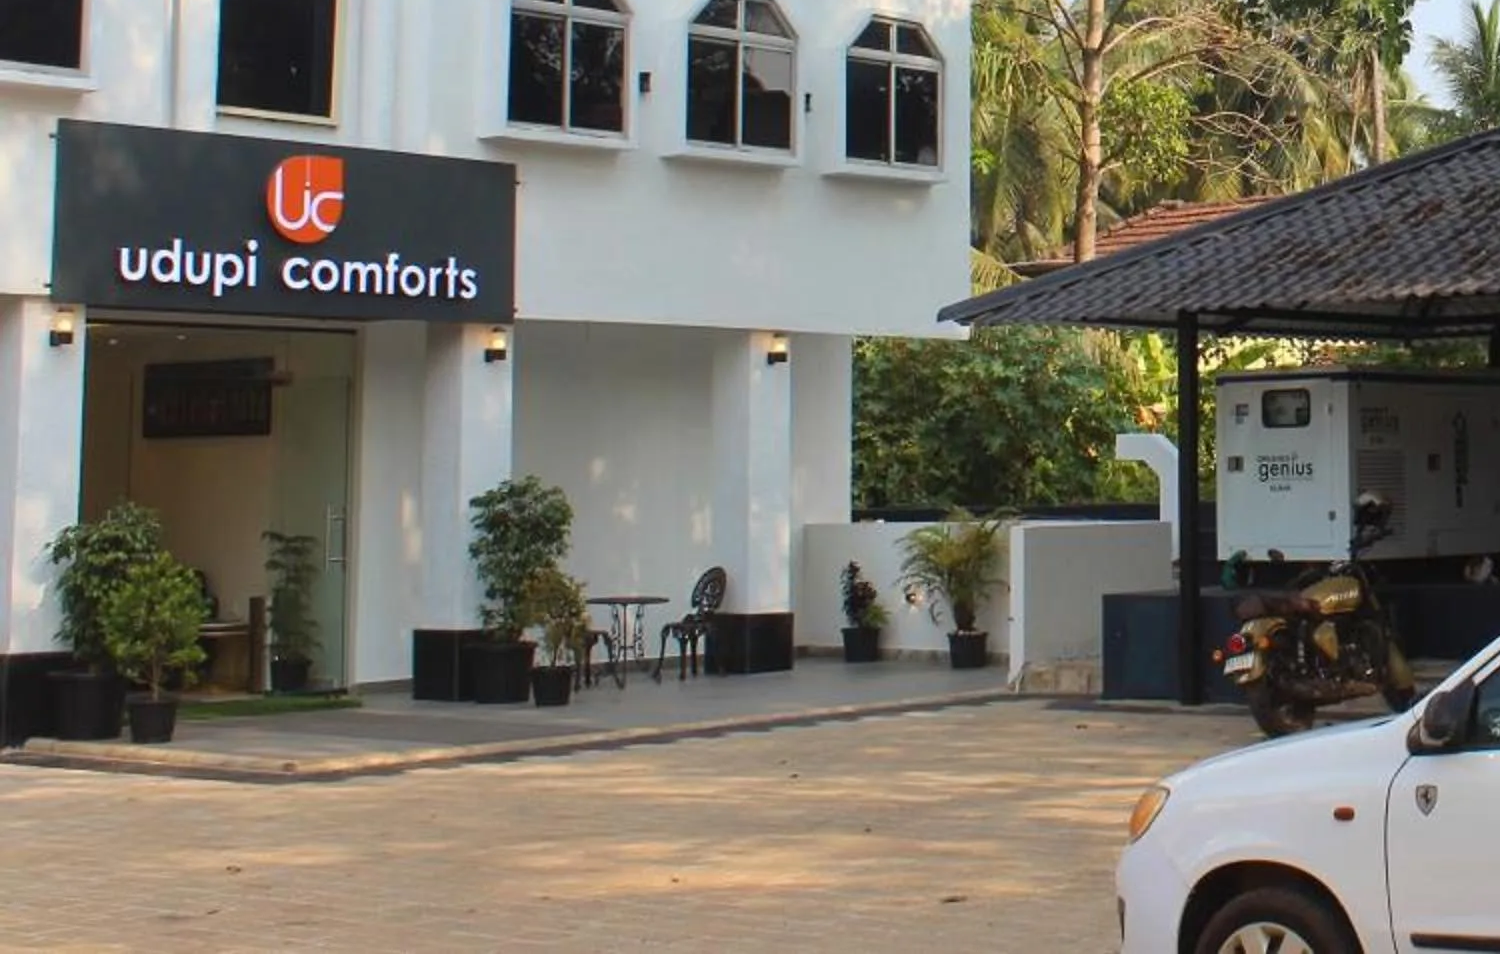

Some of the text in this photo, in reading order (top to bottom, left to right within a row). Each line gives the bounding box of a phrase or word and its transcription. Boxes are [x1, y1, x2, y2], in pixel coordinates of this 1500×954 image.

[119, 238, 479, 300] udupi comforts
[1257, 458, 1314, 483] genius
